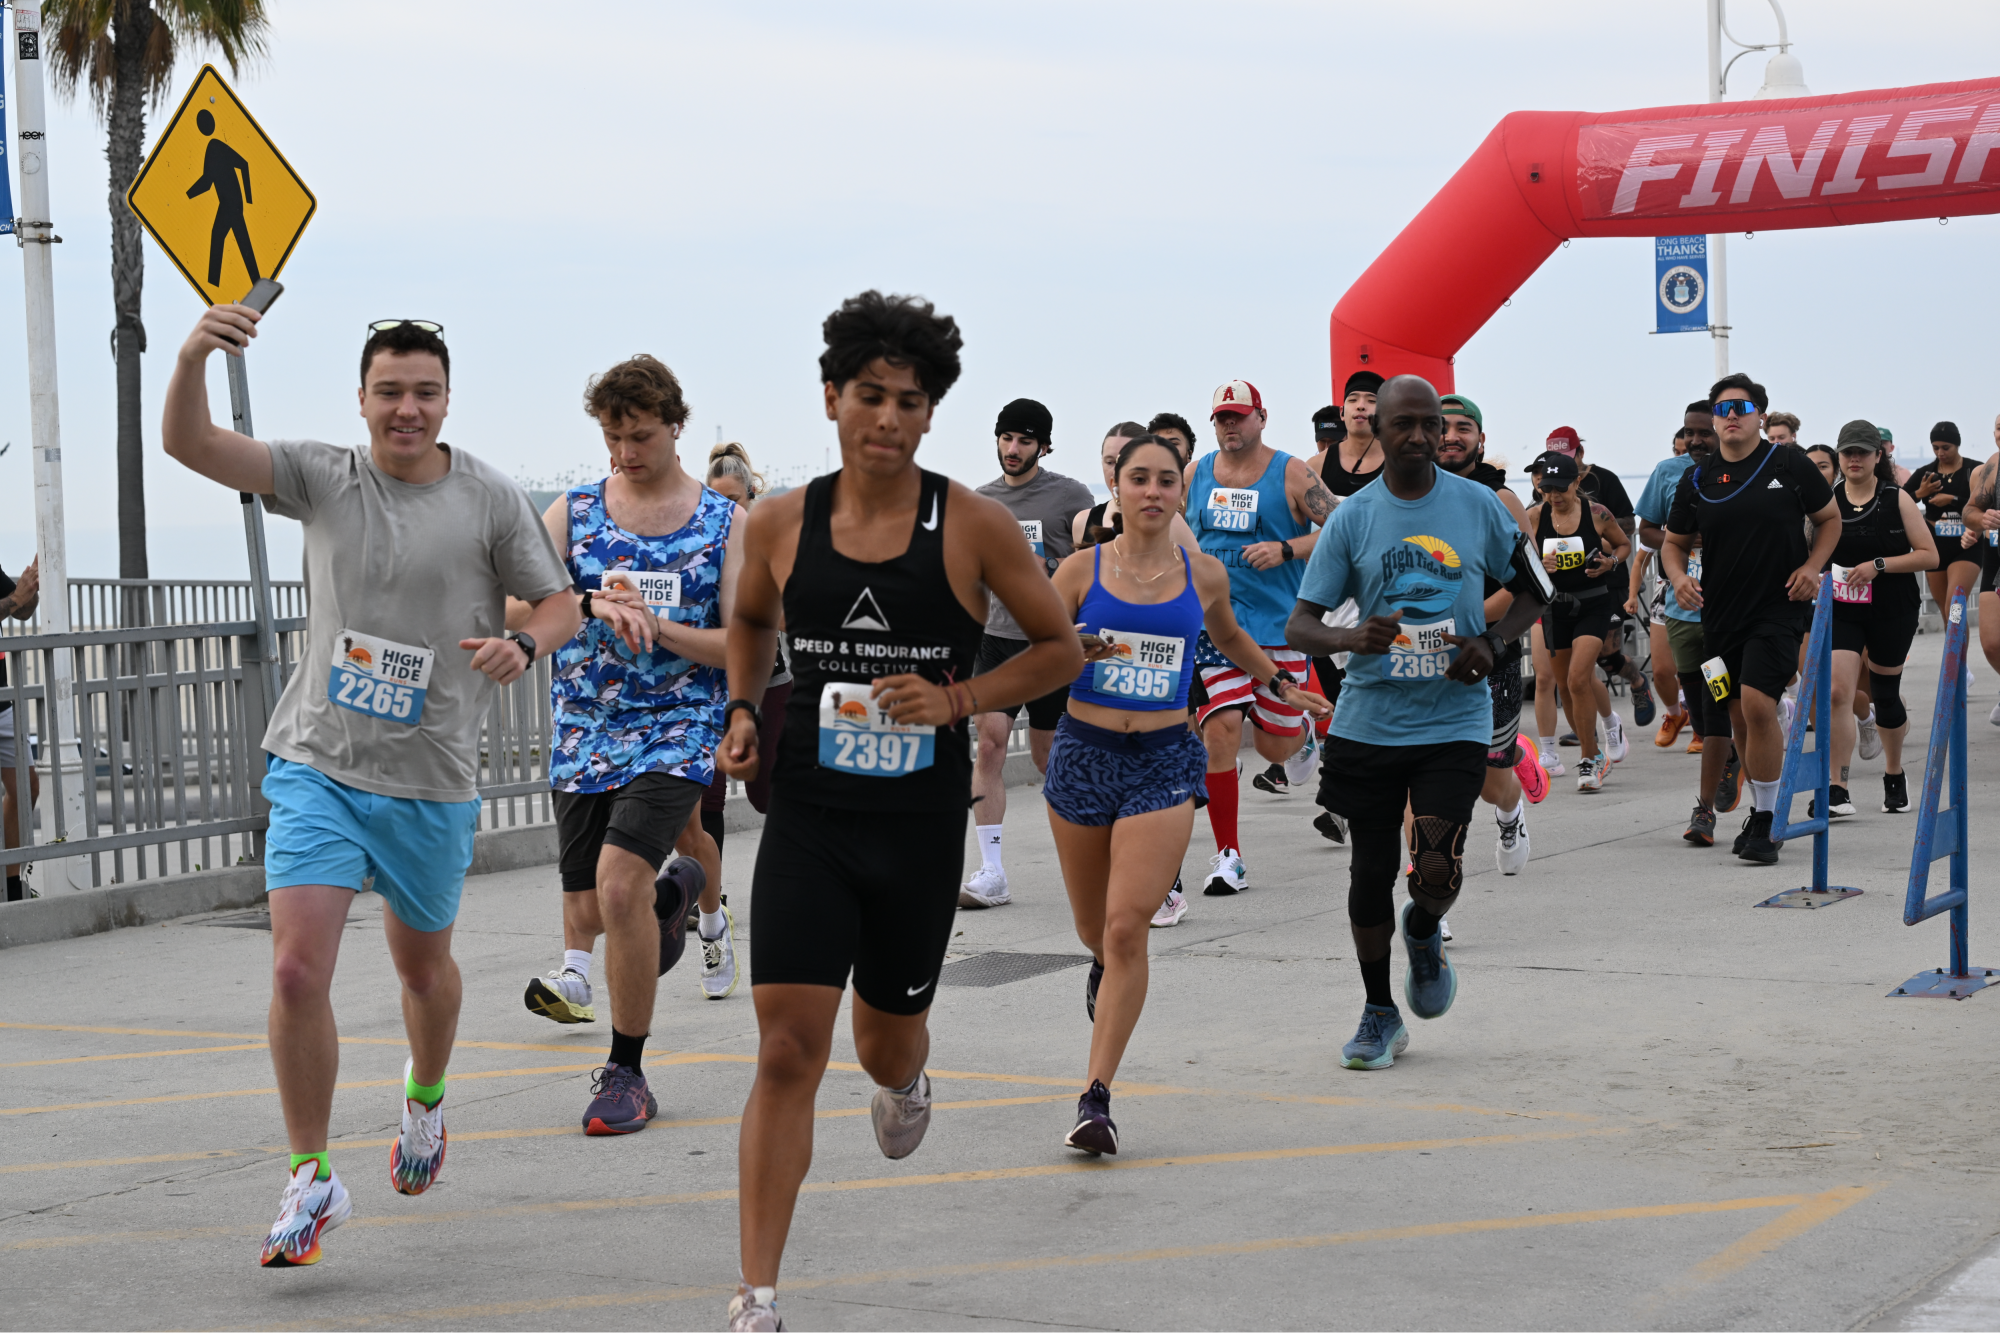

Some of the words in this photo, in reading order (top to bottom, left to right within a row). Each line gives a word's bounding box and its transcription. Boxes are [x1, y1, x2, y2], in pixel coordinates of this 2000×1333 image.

[1657, 238, 1678, 246] LONG
[1680, 236, 1705, 244] BEACH
[1657, 244, 1705, 256] THANKS
[1547, 443, 1568, 451] ciele
[1231, 493, 1253, 501] HIGH
[1213, 510, 1249, 529] 2370
[1940, 525, 1962, 536] 2371
[1381, 545, 1414, 582] High
[1415, 549, 1439, 575] Tide
[1440, 565, 1462, 580] Runs
[640, 578, 673, 590] HIGH
[1833, 582, 1869, 601] 5402
[640, 590, 672, 601] TIDE
[1418, 626, 1448, 640] HIGH
[794, 638, 834, 654] SPEED
[840, 642, 849, 654] &
[855, 643, 951, 660] ENDURANCE
[1141, 641, 1176, 654] HIGH
[382, 649, 424, 669] HIGH
[1140, 652, 1174, 665] TIDE
[1390, 652, 1450, 678] 2369
[381, 662, 421, 682] TIDE
[818, 659, 919, 675] COLLECTIVE
[389, 677, 407, 685] RUNS
[1102, 665, 1170, 698] 2395
[1709, 676, 1729, 698] 61
[336, 672, 414, 718] 2265
[834, 732, 920, 772] 2397
